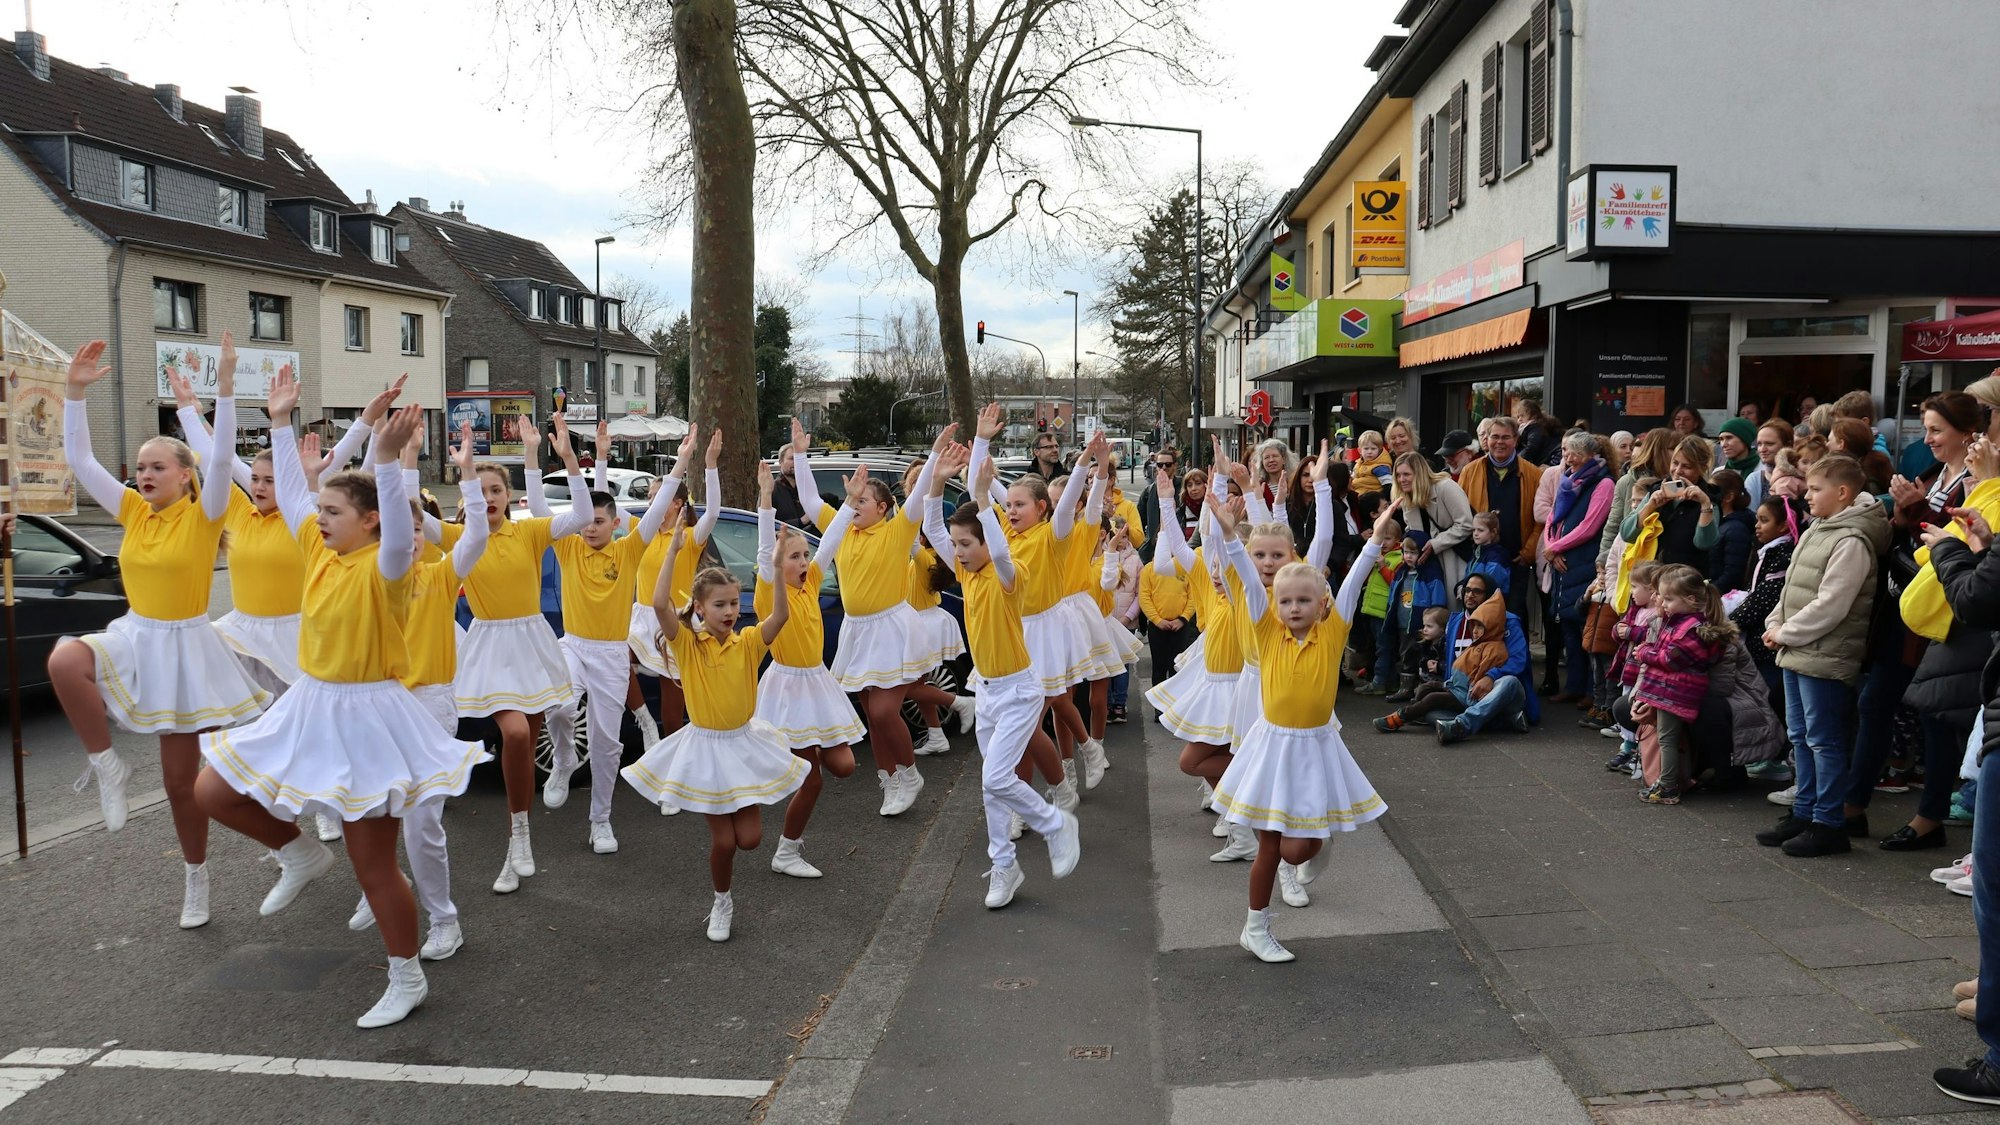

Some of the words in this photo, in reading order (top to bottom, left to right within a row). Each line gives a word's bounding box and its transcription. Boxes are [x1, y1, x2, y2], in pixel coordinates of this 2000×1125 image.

[1608, 201, 1668, 209] Familientreff
[1360, 236, 1397, 244] DHL
[1622, 353, 1668, 362] Öffnungszeiten
